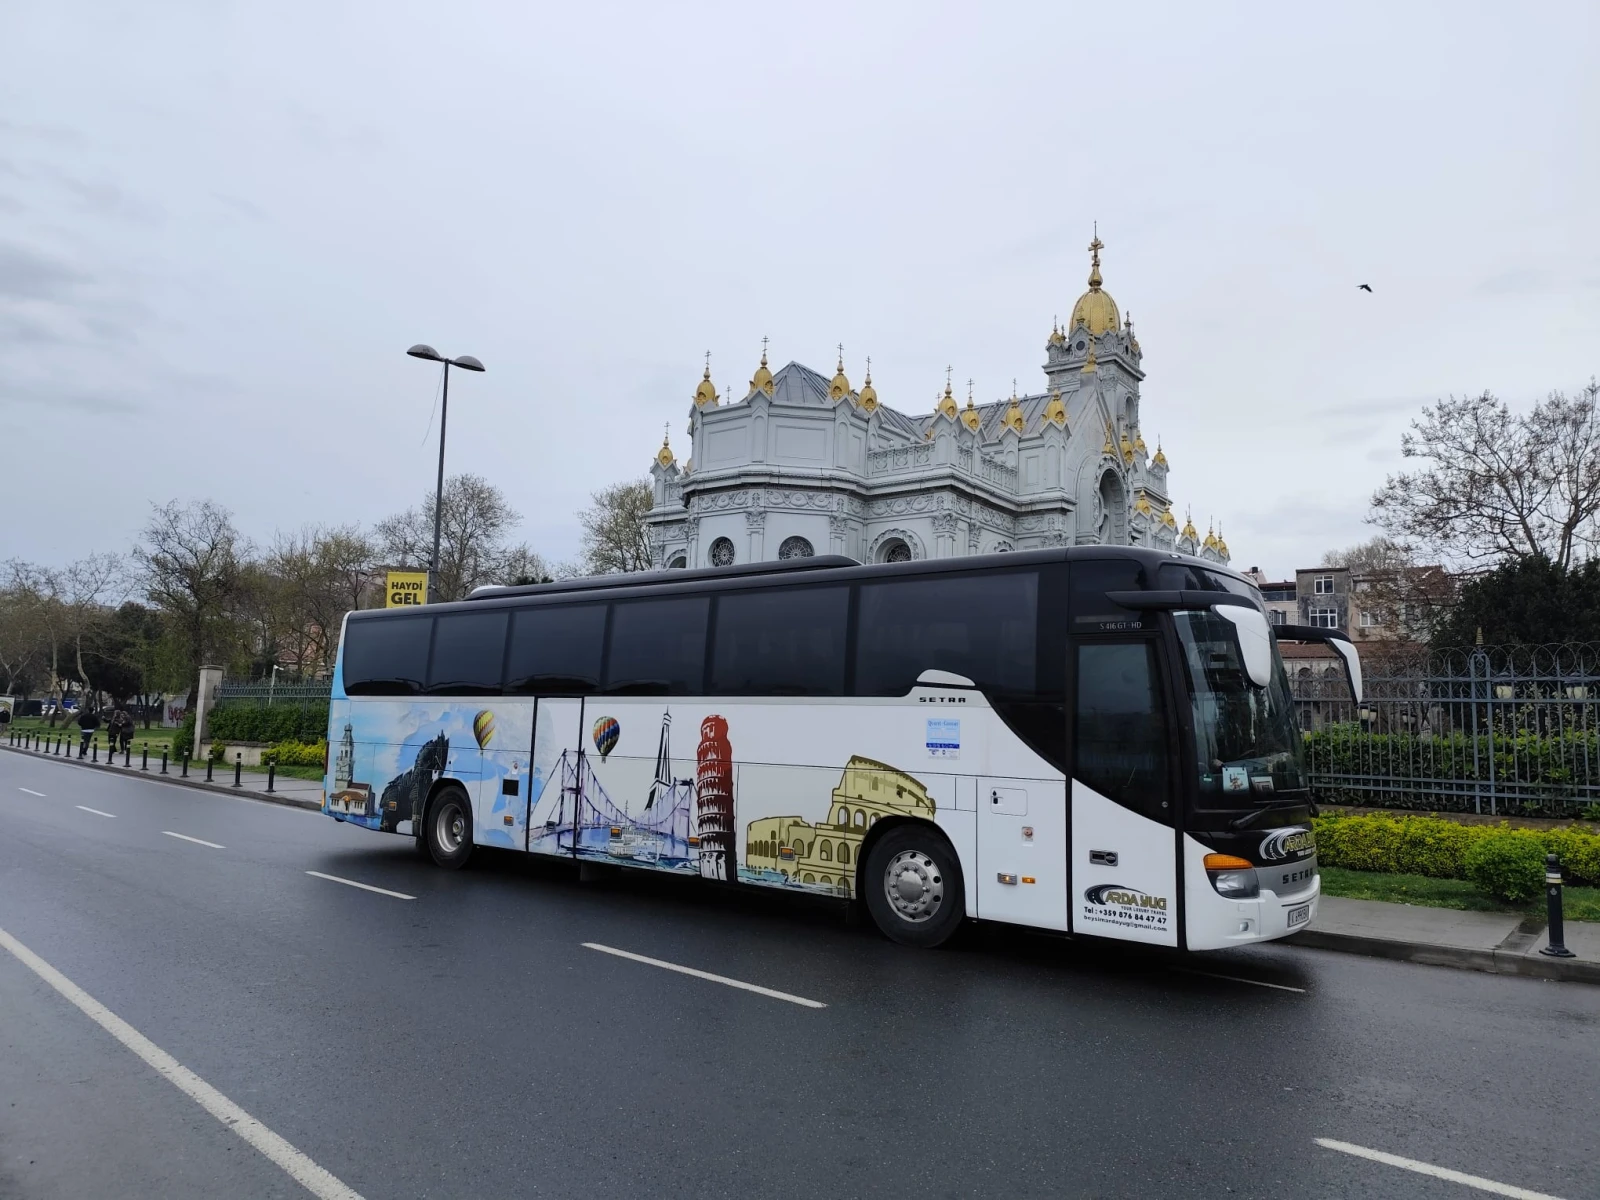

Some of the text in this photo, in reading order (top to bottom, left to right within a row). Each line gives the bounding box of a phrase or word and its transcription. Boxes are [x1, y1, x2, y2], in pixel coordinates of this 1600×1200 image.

[391, 592, 421, 605] GEL
[1100, 622, 1104, 630] S
[1105, 622, 1117, 630] 416
[1105, 891, 1167, 911] ARDA YUG
[1098, 909, 1117, 917] +359
[1118, 911, 1132, 919] 876
